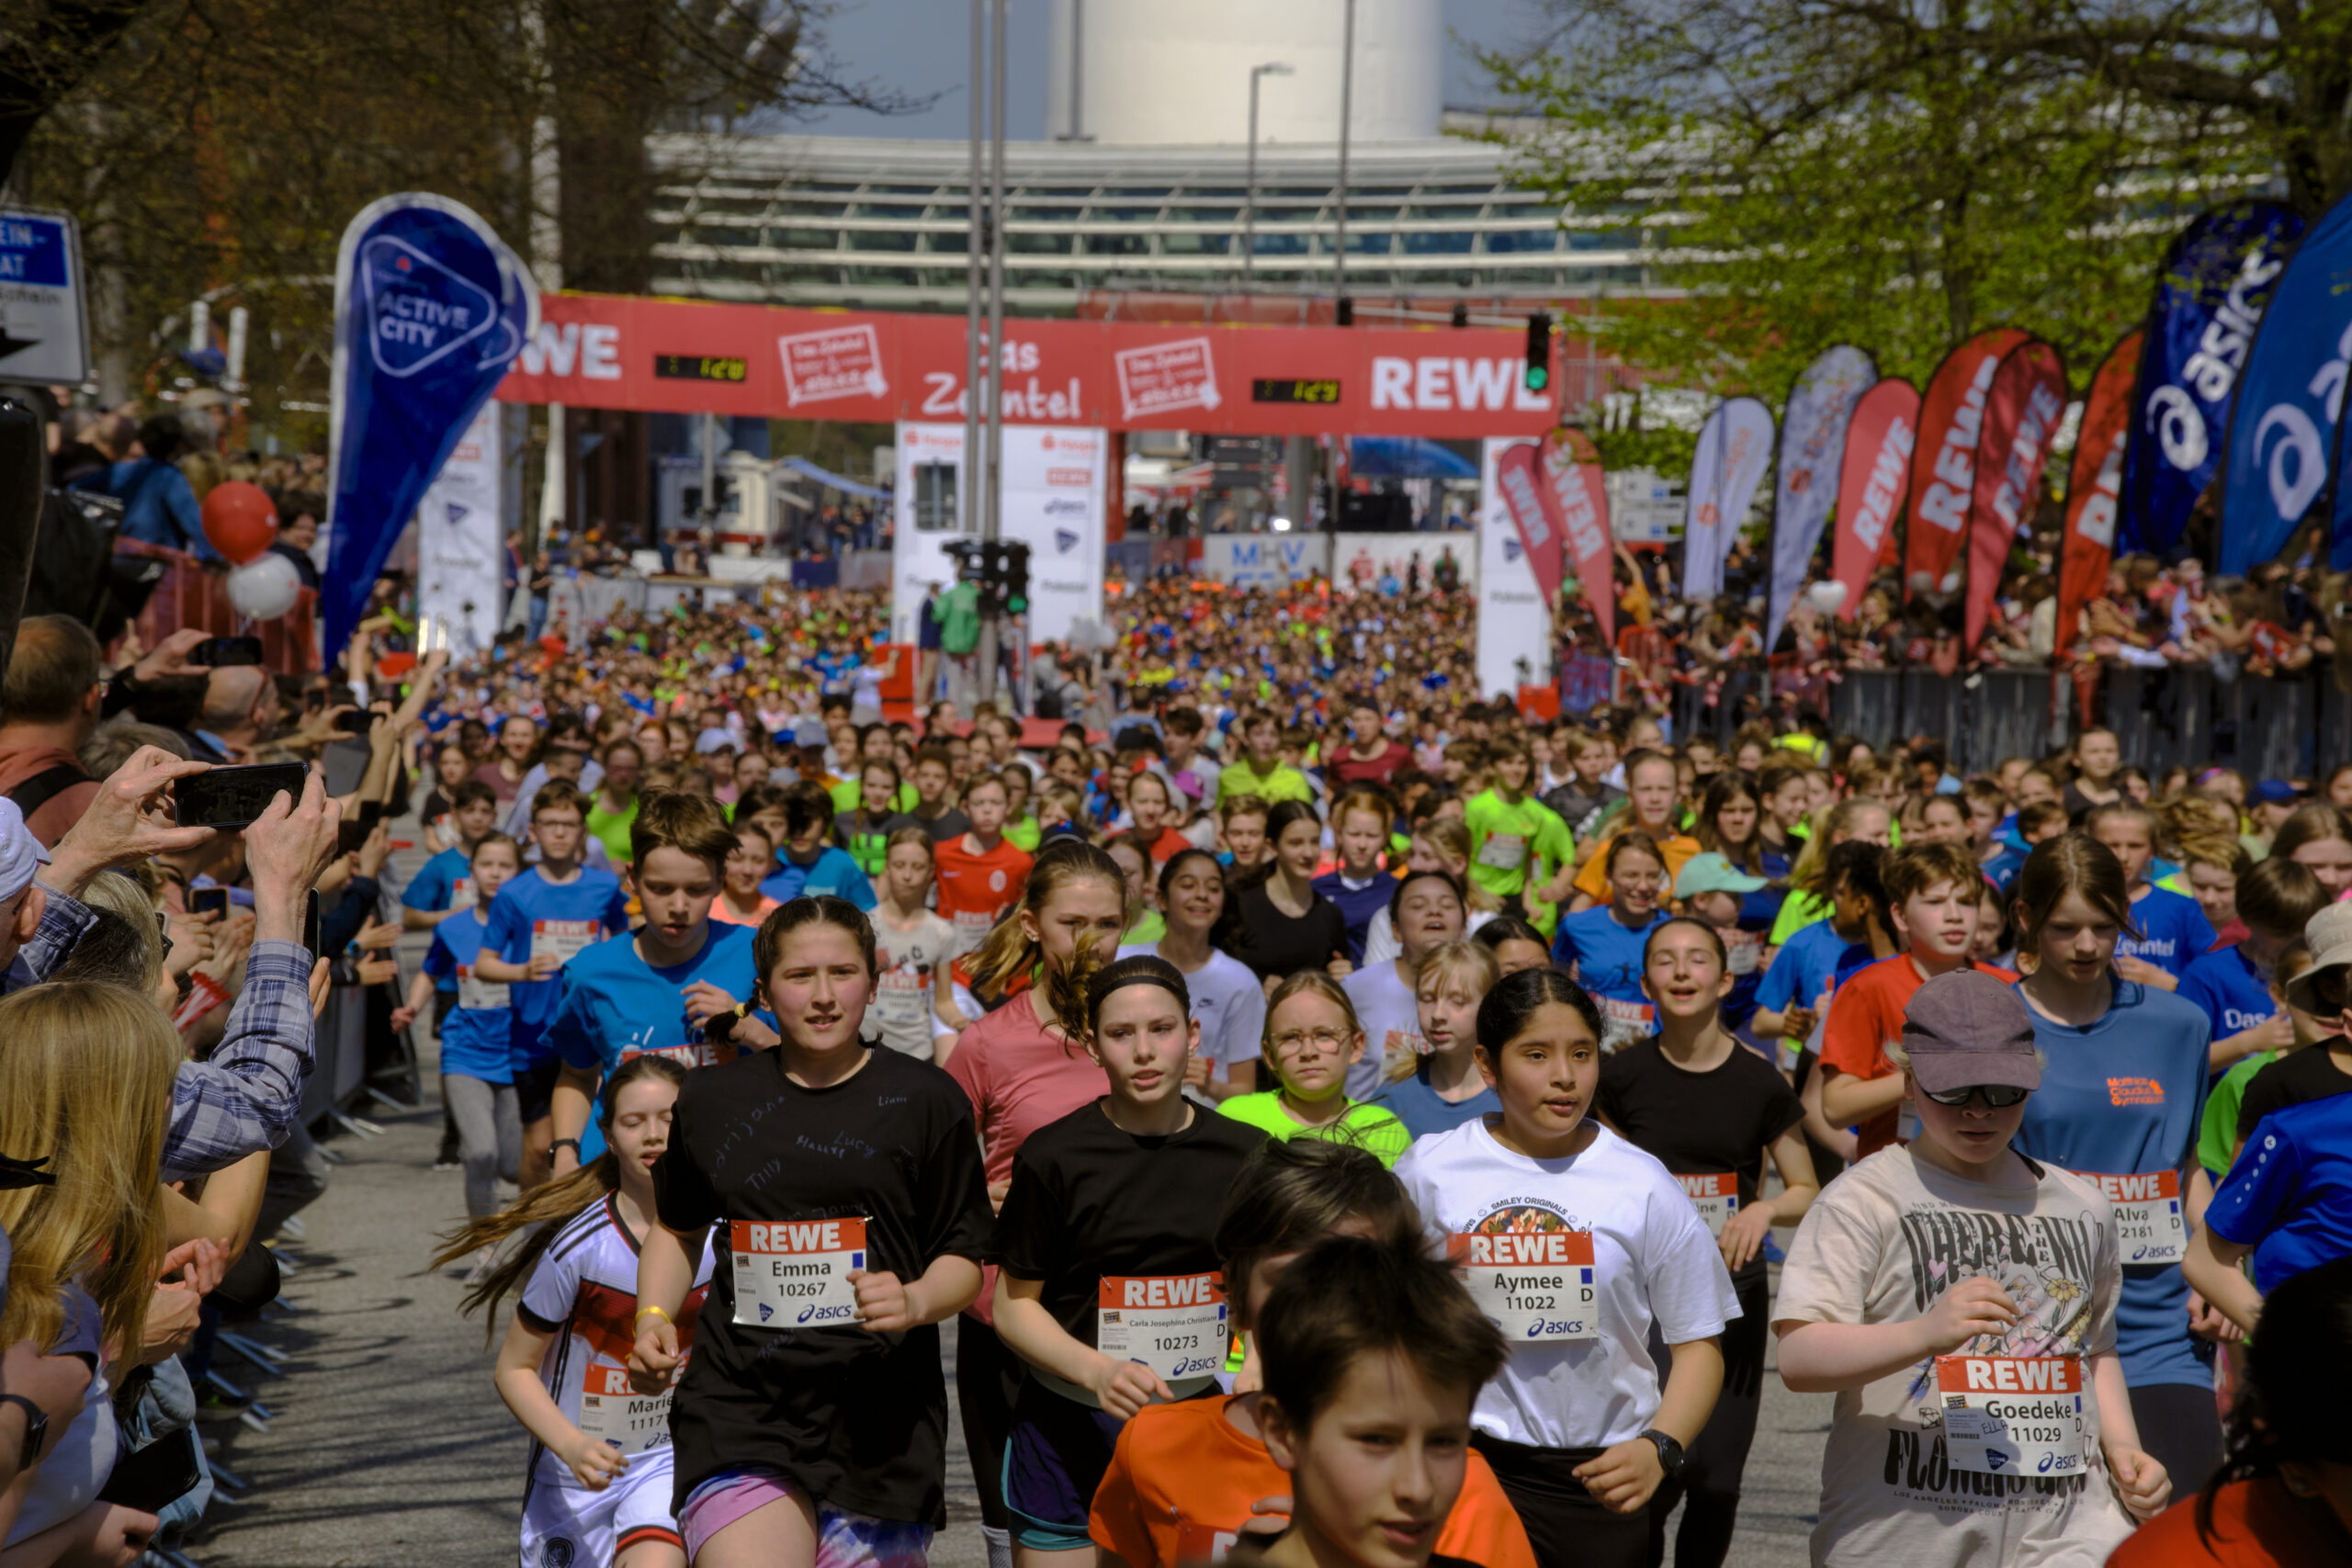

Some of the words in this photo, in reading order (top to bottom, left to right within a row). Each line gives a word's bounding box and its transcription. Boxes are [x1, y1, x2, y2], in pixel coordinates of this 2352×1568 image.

[378, 289, 469, 330] ACTIVE
[379, 316, 438, 349] CITY
[509, 322, 623, 380] WE
[1993, 379, 2060, 530] REWE
[1852, 415, 1916, 553] REWE
[1542, 443, 1605, 564] REWE
[1232, 540, 1305, 568] MHV
[2224, 1009, 2267, 1030] Das
[643, 1044, 719, 1068] EWE
[877, 1096, 908, 1107] Liam
[833, 1129, 876, 1159] Lucy
[744, 1157, 781, 1191] Tilly
[1679, 1176, 1720, 1196] WE
[1491, 1197, 1522, 1211] SMILEY
[1524, 1196, 1568, 1216] ORIGINALS
[2115, 1207, 2149, 1221] Alva
[2170, 1217, 2181, 1230] D
[750, 1222, 842, 1252] REWE
[2031, 1223, 2050, 1263] THE
[1471, 1235, 1568, 1264] REWE
[2148, 1246, 2177, 1258] asics
[772, 1261, 831, 1277] Emma
[778, 1282, 827, 1297] 10267
[1124, 1275, 1212, 1307] REWE
[1494, 1273, 1564, 1293] Aymee
[1506, 1296, 1555, 1310] 11022
[1580, 1288, 1593, 1303] D
[815, 1304, 852, 1319] asics
[1129, 1320, 1148, 1328] Carla
[1216, 1323, 1226, 1337] D
[1545, 1321, 1583, 1334] asics
[1154, 1335, 1199, 1351] 10273
[1188, 1356, 1216, 1372] asics
[1965, 1359, 2068, 1391] REWE
[628, 1394, 673, 1415] Marie
[1985, 1400, 2072, 1420] Goedeke
[630, 1414, 669, 1430] 1117
[1981, 1418, 2009, 1435] ELLA
[2075, 1417, 2083, 1433] D
[2011, 1427, 2062, 1442] 11029
[2055, 1454, 2077, 1470] asics
[1894, 1491, 1910, 1499] LOS
[1914, 1495, 1958, 1505] ANGELES
[1969, 1499, 2007, 1509] PALOMA
[1979, 1508, 2004, 1517] COUN
